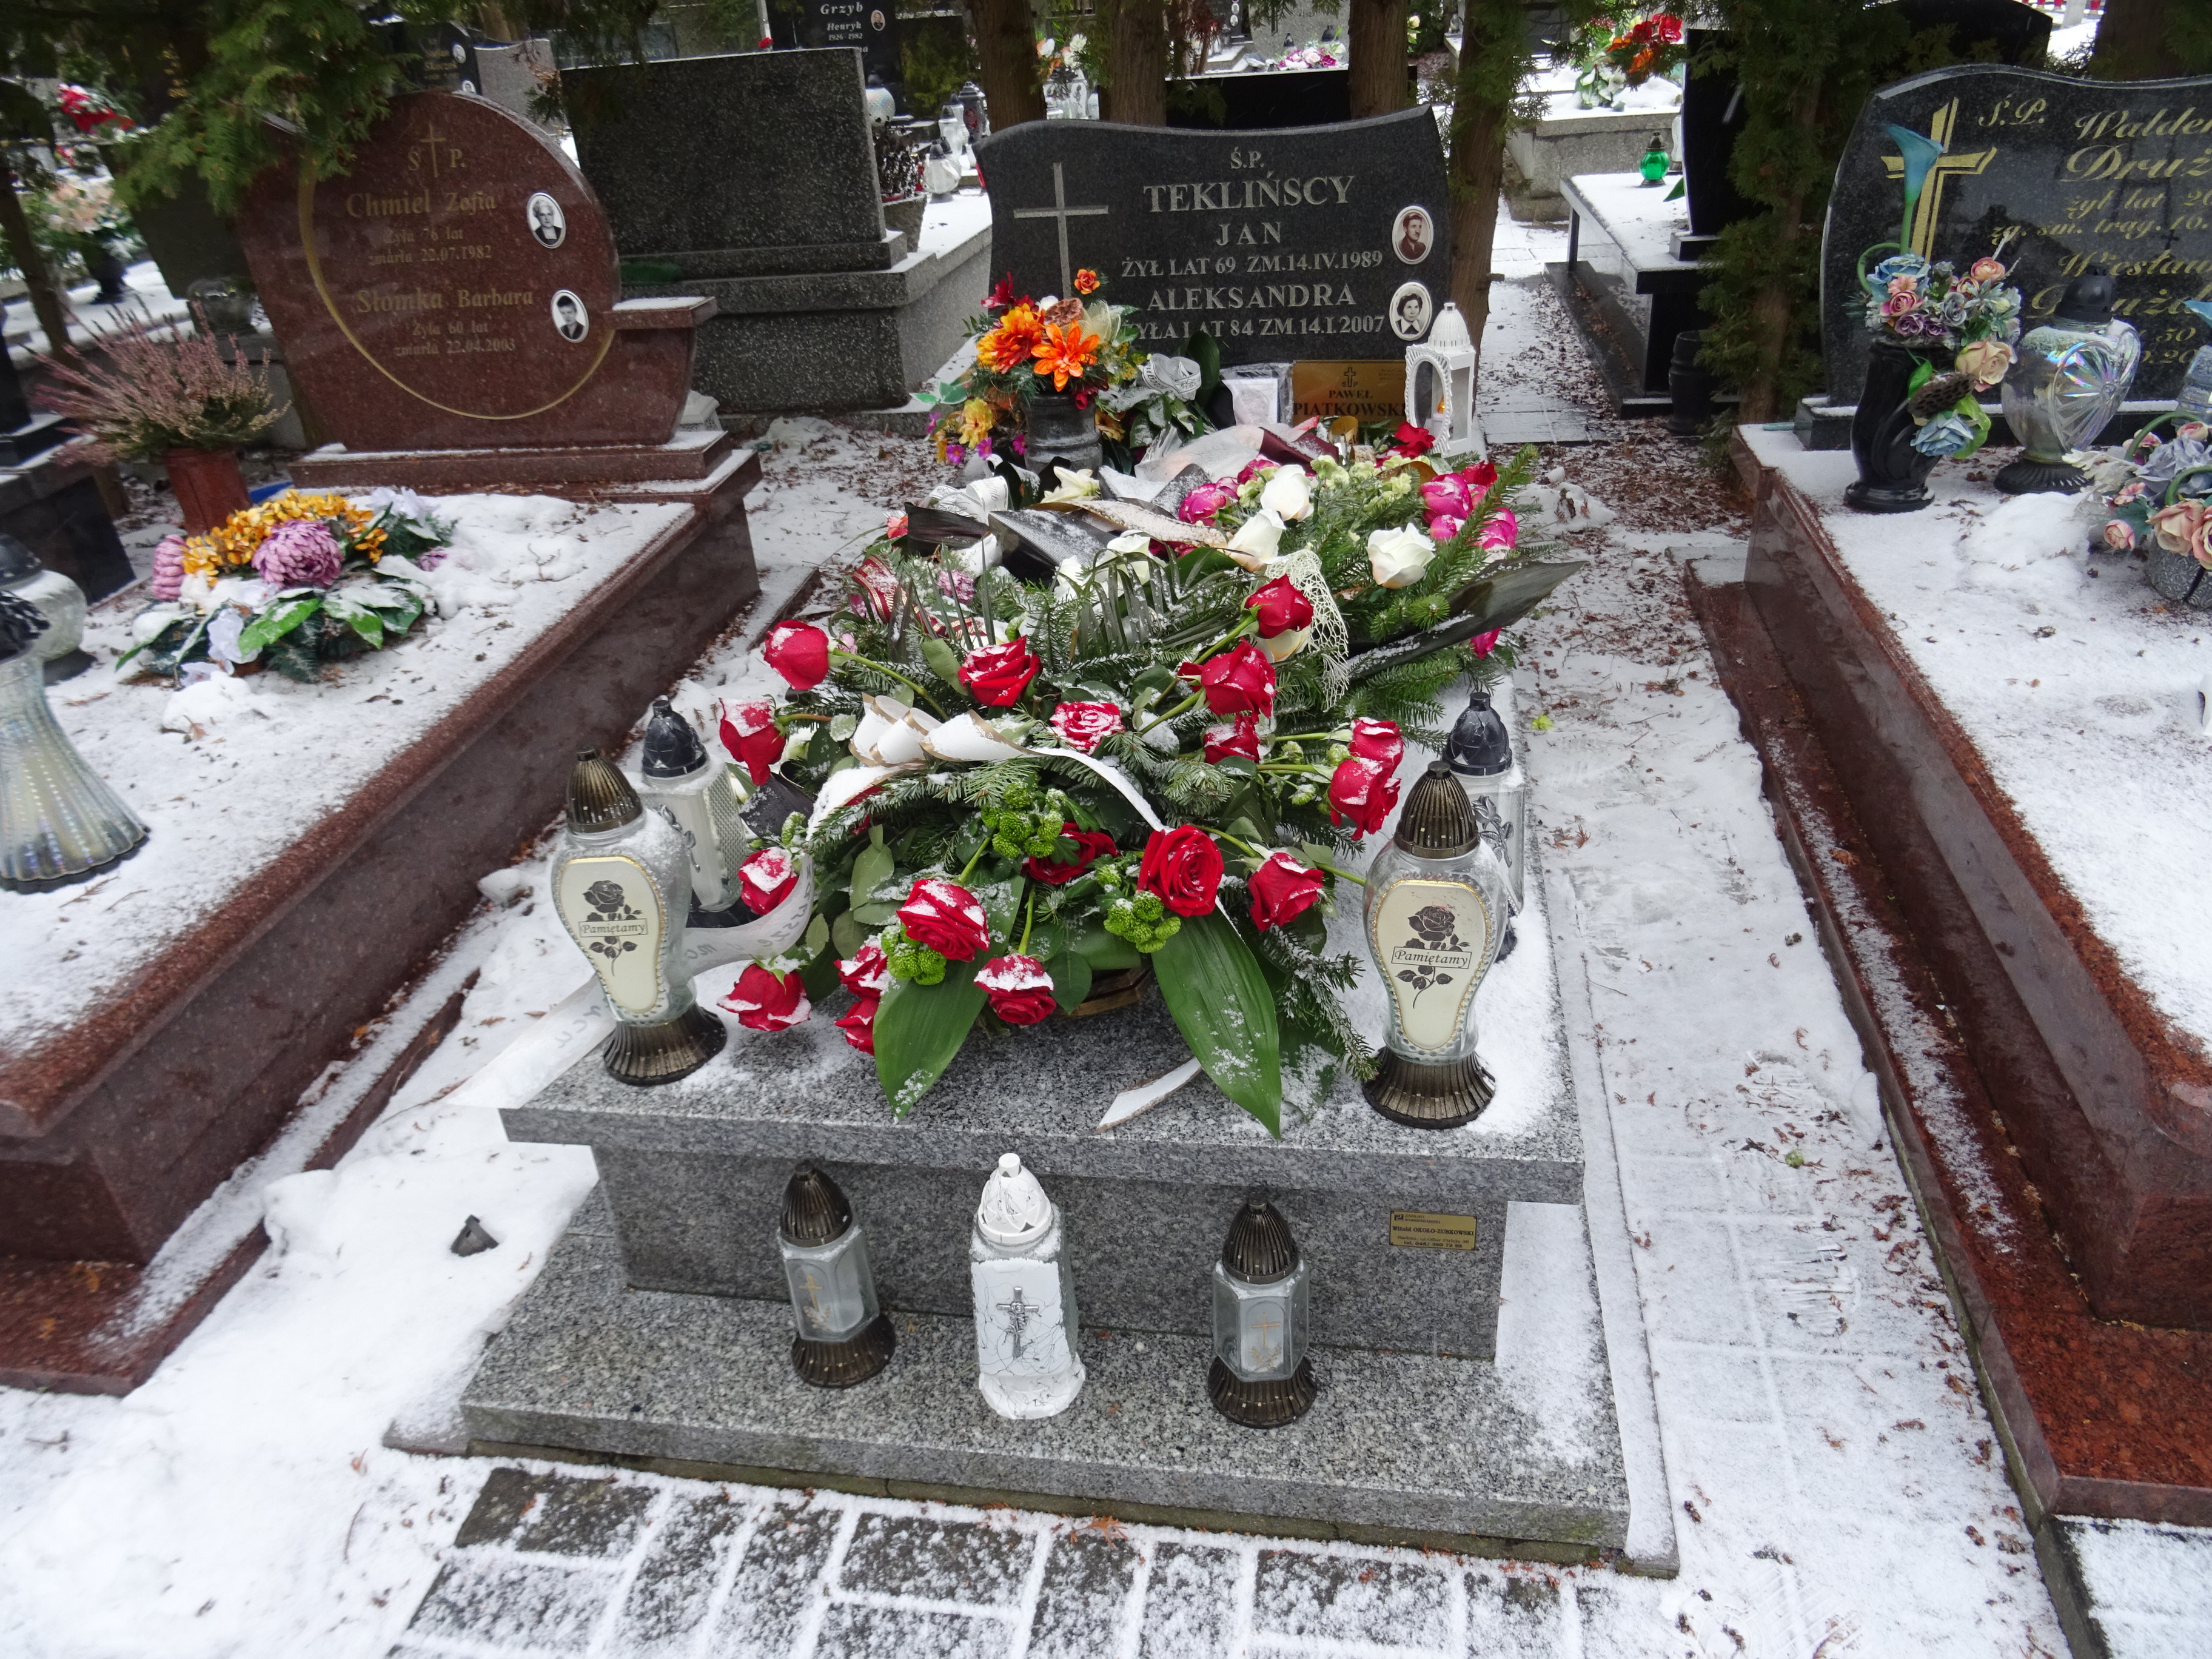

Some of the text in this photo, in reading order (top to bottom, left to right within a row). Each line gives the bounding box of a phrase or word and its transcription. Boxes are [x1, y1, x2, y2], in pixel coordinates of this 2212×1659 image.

[820, 1, 863, 16] Grzyb
[826, 21, 862, 32] Henryk
[1230, 146, 1264, 169] Ś.P.
[1144, 171, 1355, 212] TEKLIŃSCY
[346, 189, 497, 218] Chmiel Zofia
[2067, 189, 2114, 220] żył
[2124, 189, 2165, 209] lat
[446, 226, 463, 240] lat
[1215, 222, 1282, 246] JAN
[421, 245, 492, 261] 22.07.1982
[1121, 250, 1383, 277] ŻYŁ LAT 69 ZM.14.IV.1989
[357, 287, 533, 312] Słomka Barbara
[1147, 283, 1356, 311] ALEKSANDRA
[471, 320, 489, 333] lat
[1230, 320, 1253, 336] 84
[581, 922, 646, 935] Pamiętamy
[1395, 950, 1468, 968] Pamiętamy
